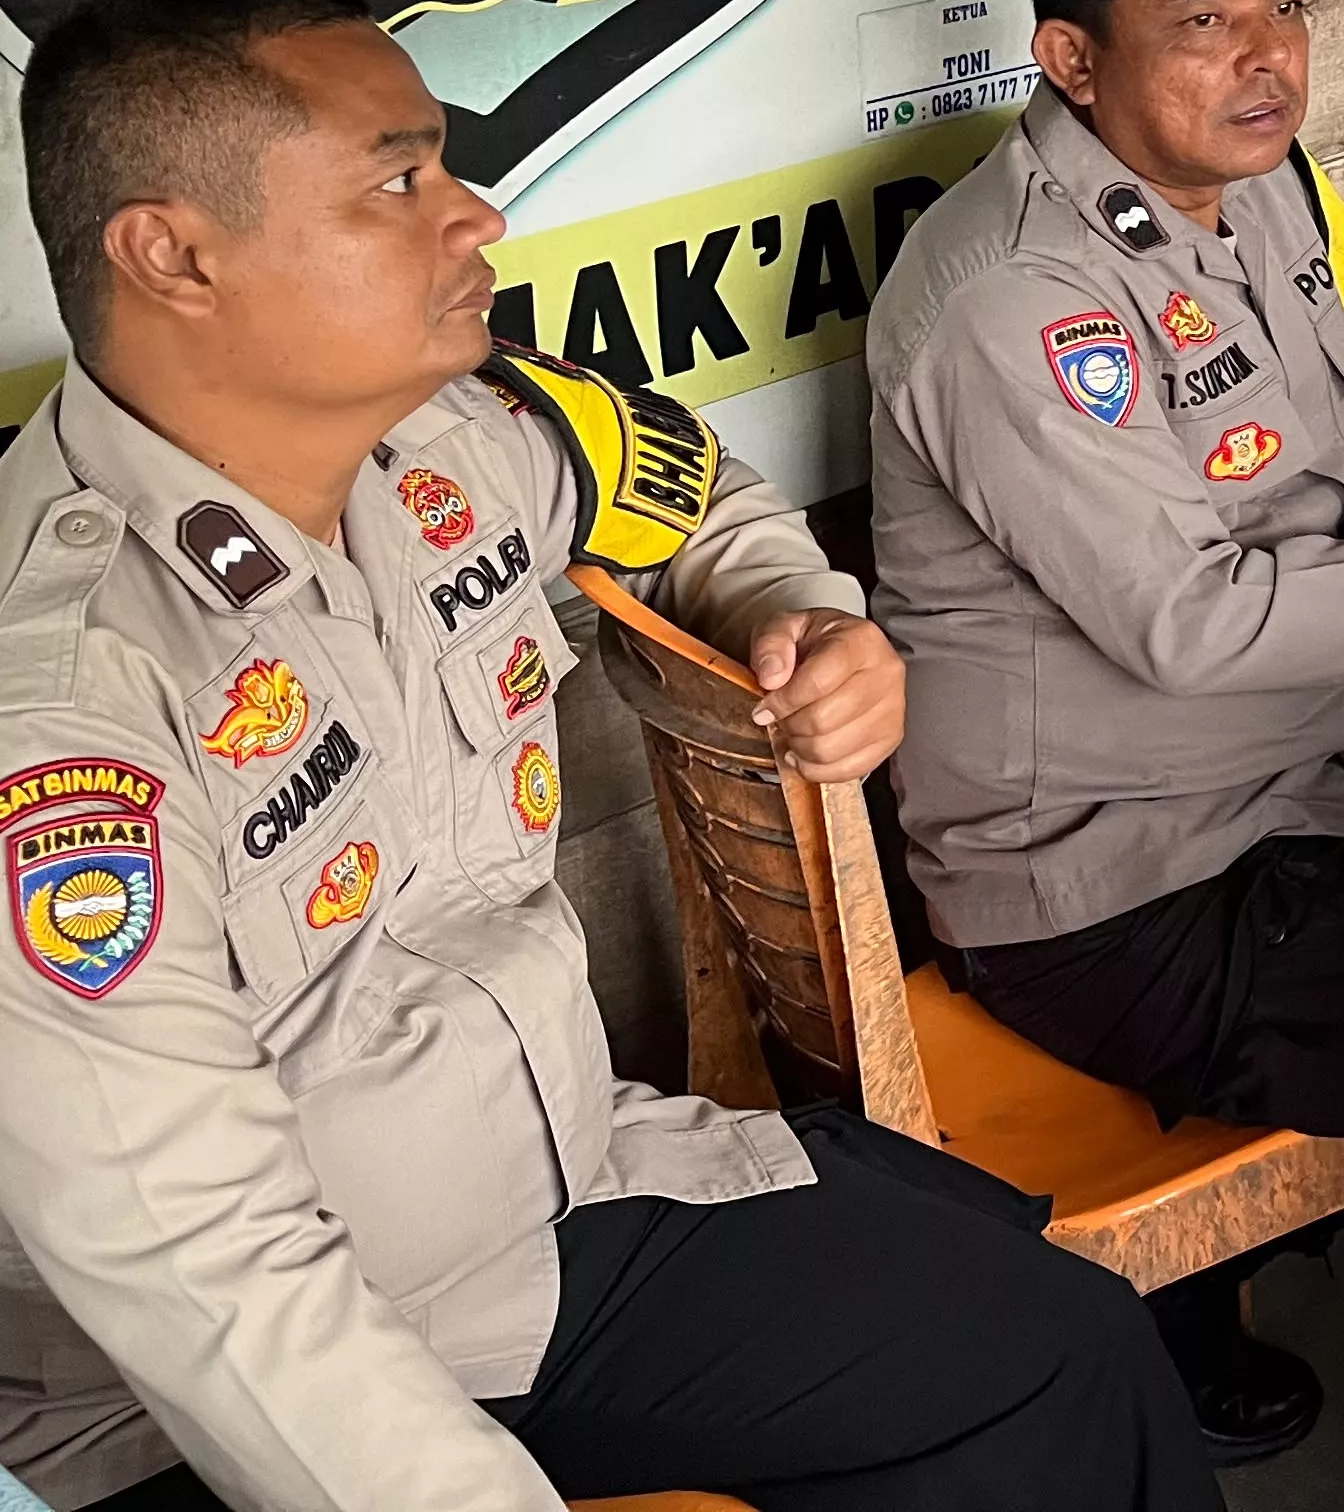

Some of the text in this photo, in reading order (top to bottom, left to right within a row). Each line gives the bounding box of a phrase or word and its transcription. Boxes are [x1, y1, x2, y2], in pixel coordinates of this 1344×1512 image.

[943, 1, 988, 24] KETUA
[943, 49, 990, 80] TONI
[866, 107, 889, 132] HP
[932, 88, 973, 117] 0823
[978, 77, 1018, 106] 7177
[1293, 250, 1334, 306] PO
[1054, 321, 1122, 346] BINMAS
[430, 527, 532, 632] POLRI
[22, 823, 147, 861] BINMAS
